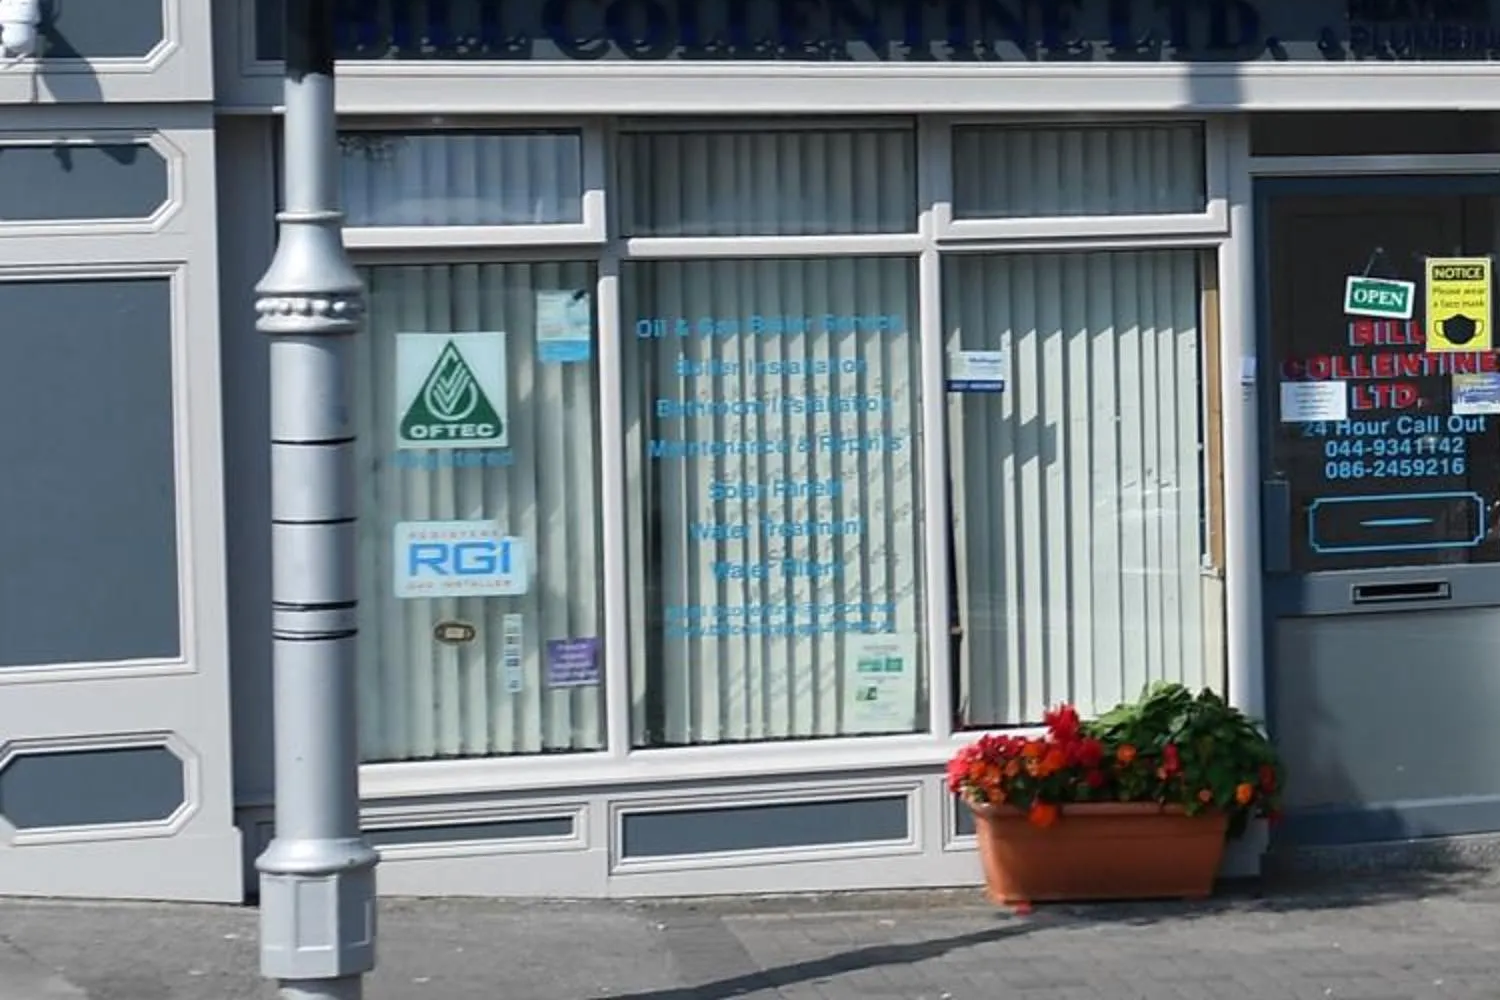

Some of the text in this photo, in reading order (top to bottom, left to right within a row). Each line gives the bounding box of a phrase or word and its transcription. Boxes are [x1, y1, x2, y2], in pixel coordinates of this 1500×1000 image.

[1433, 267, 1484, 279] NOTICE
[1353, 287, 1404, 308] OPEN
[1350, 319, 1426, 347] BILL
[409, 423, 495, 439] OFTEC
[1336, 417, 1388, 436] Hour
[1397, 415, 1440, 434] Call
[1447, 414, 1486, 433] Out
[1325, 457, 1466, 479] 086-2459216
[409, 541, 512, 577] RGI
